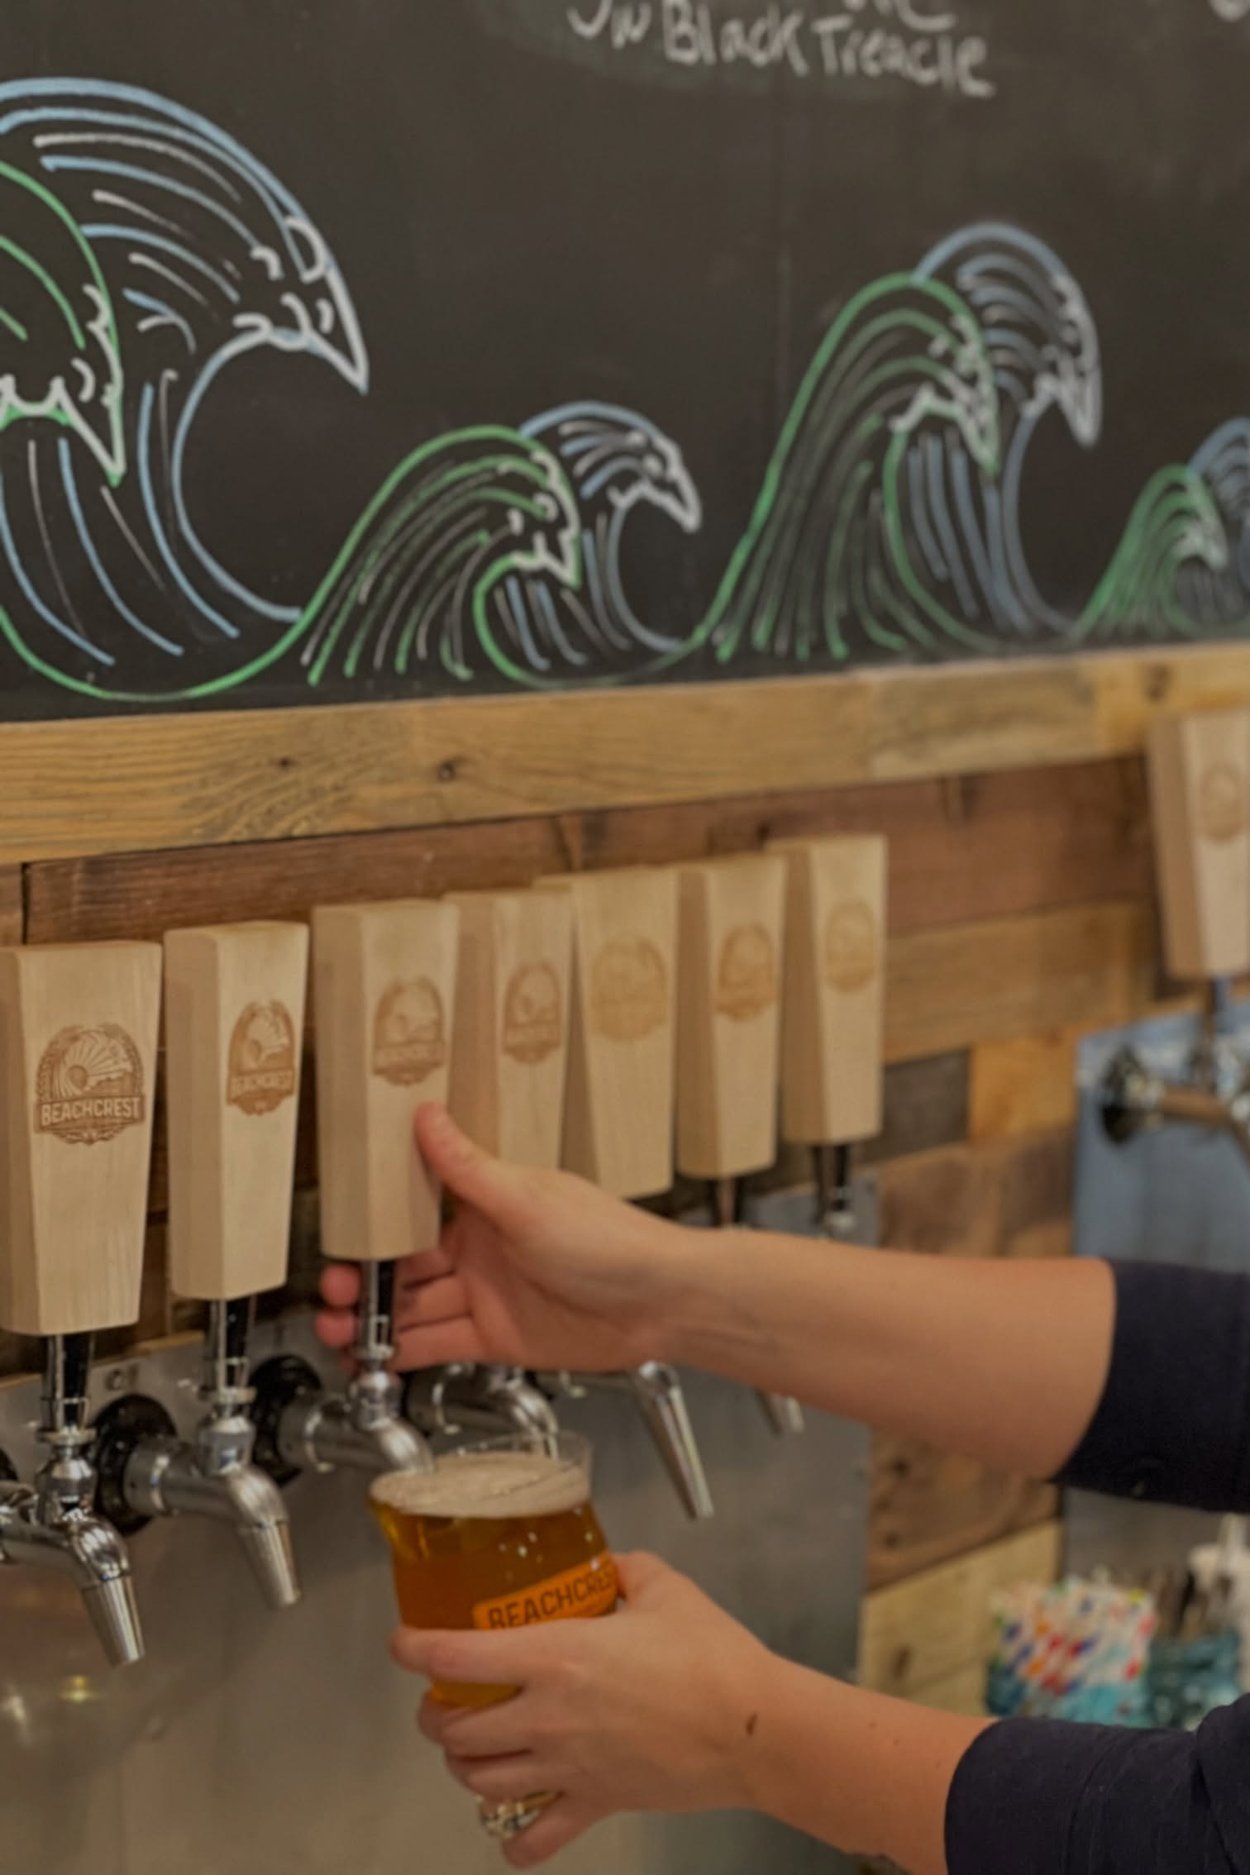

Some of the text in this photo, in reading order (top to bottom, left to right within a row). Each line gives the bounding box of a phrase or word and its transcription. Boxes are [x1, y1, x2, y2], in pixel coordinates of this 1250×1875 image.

[661, 0, 808, 76] Black
[812, 15, 996, 98] Treacle
[41, 1098, 140, 1127] BEACHCREST
